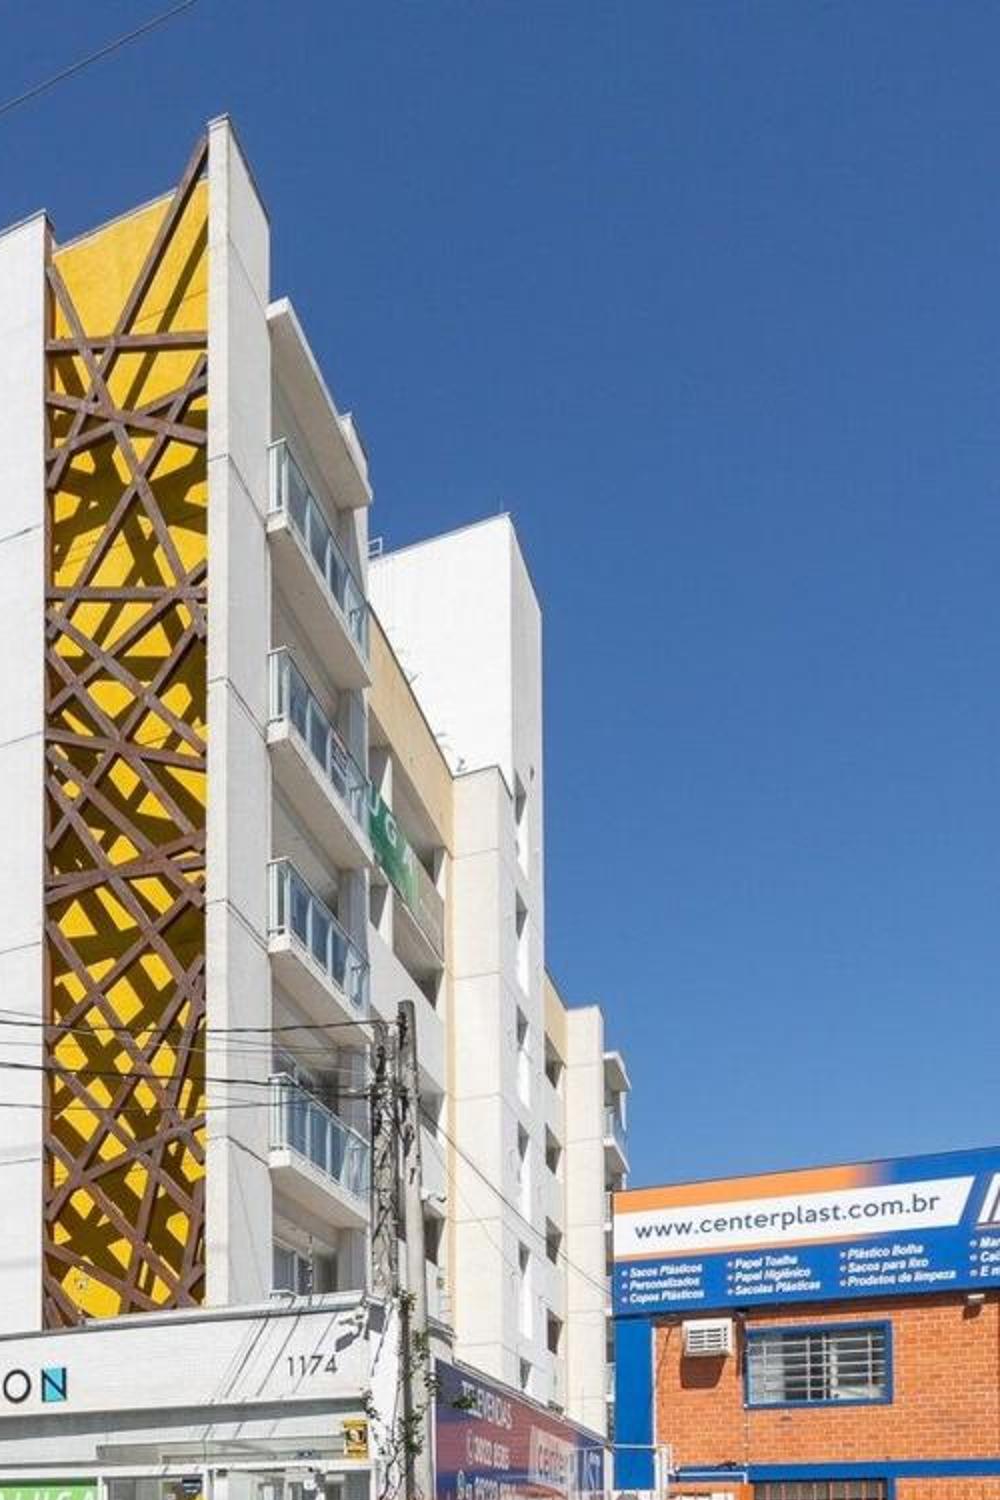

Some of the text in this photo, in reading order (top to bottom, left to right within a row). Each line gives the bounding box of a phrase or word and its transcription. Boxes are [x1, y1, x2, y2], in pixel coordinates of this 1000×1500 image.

[635, 1193, 940, 1239] www.centerplast.com.br
[848, 1243, 924, 1259] Plástico Bolha
[735, 1254, 798, 1270] Papel Toalha
[848, 1262, 880, 1273] Sacos
[881, 1260, 907, 1273] para
[630, 1263, 703, 1279] Sacos Plásticos
[735, 1267, 811, 1283] Papel Higiênico
[848, 1269, 956, 1287] Produtos de limpeza
[980, 1265, 990, 1277] E
[630, 1277, 700, 1291] Personalizados
[735, 1280, 821, 1296] Sacolas Plásticas
[630, 1288, 705, 1304] Copos Plásticos
[288, 1354, 338, 1376] 1174
